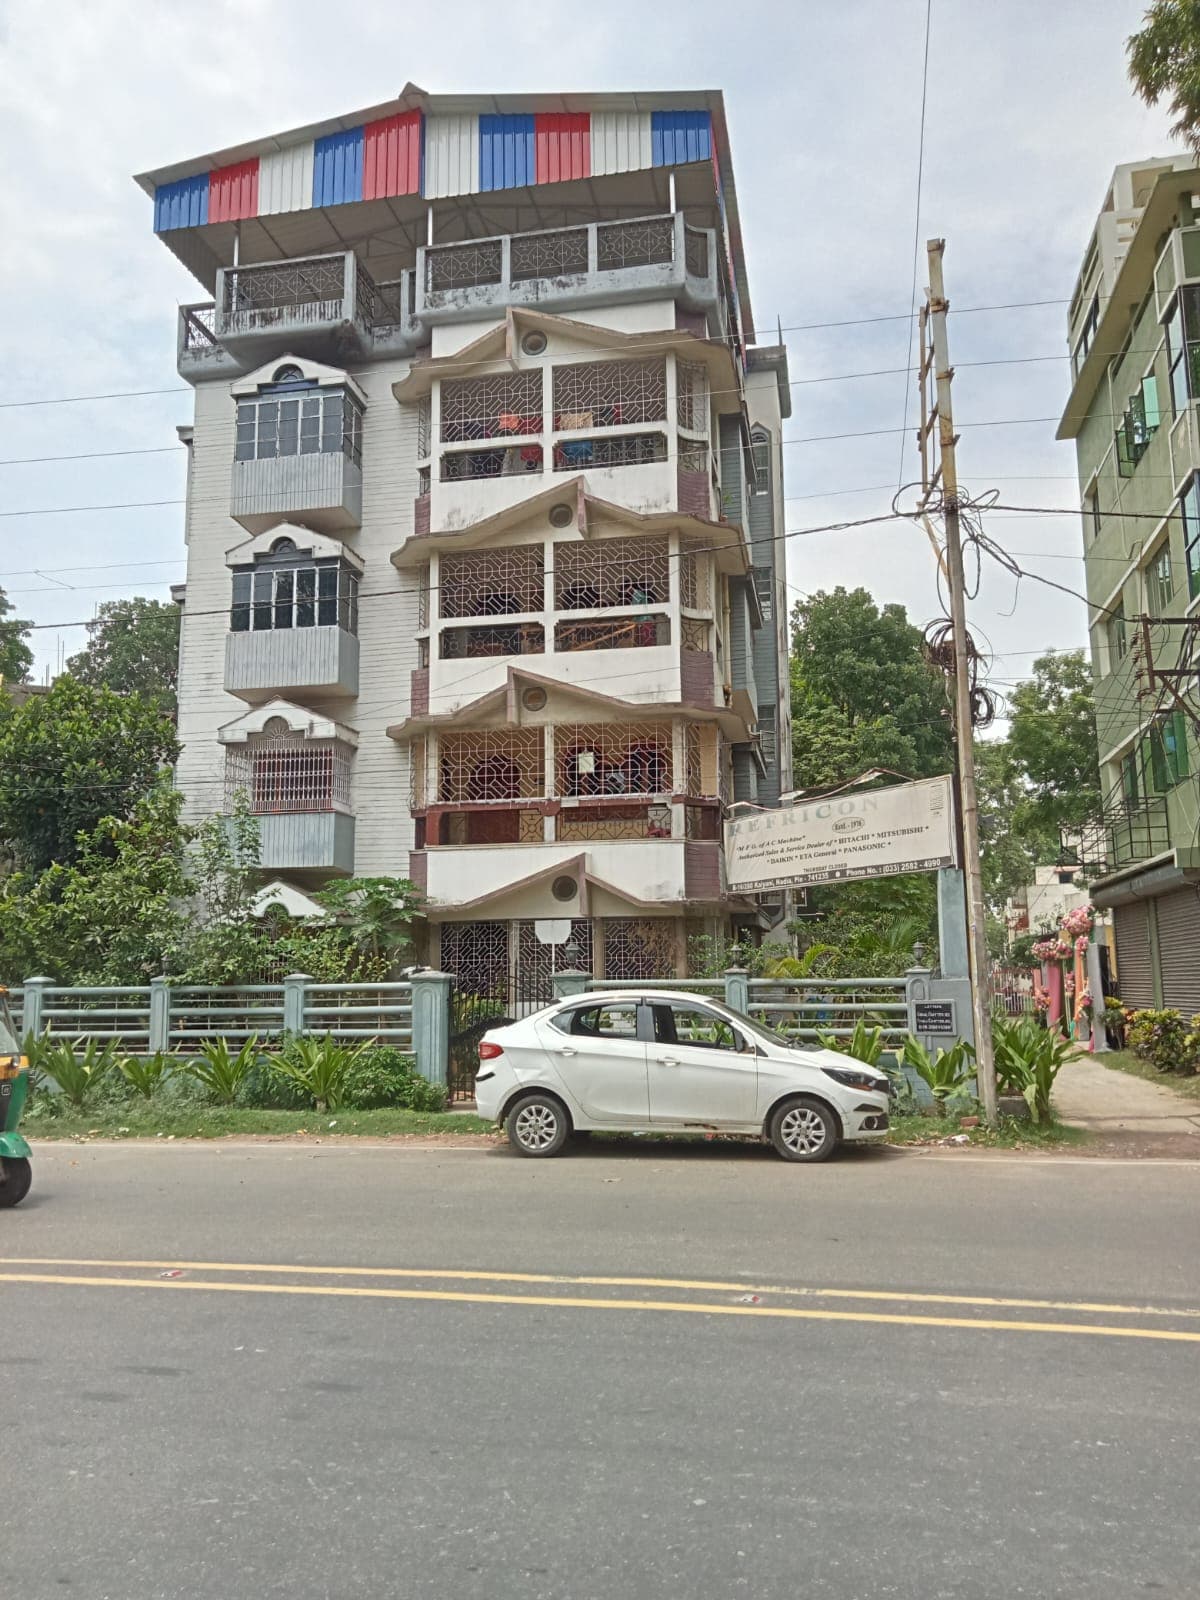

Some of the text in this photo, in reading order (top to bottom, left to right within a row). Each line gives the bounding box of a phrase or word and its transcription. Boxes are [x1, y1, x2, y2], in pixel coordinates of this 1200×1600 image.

[728, 799, 878, 837] REFRICON
[806, 840, 825, 848] Dealer
[826, 839, 833, 847] of
[838, 835, 870, 844] HITACHI
[877, 826, 923, 838] MITSUBISHI
[770, 856, 793, 864] DAIKIN
[813, 848, 836, 857] General
[843, 843, 885, 853] PANASONIC
[807, 872, 829, 881] 741235
[846, 868, 866, 877] Phone
